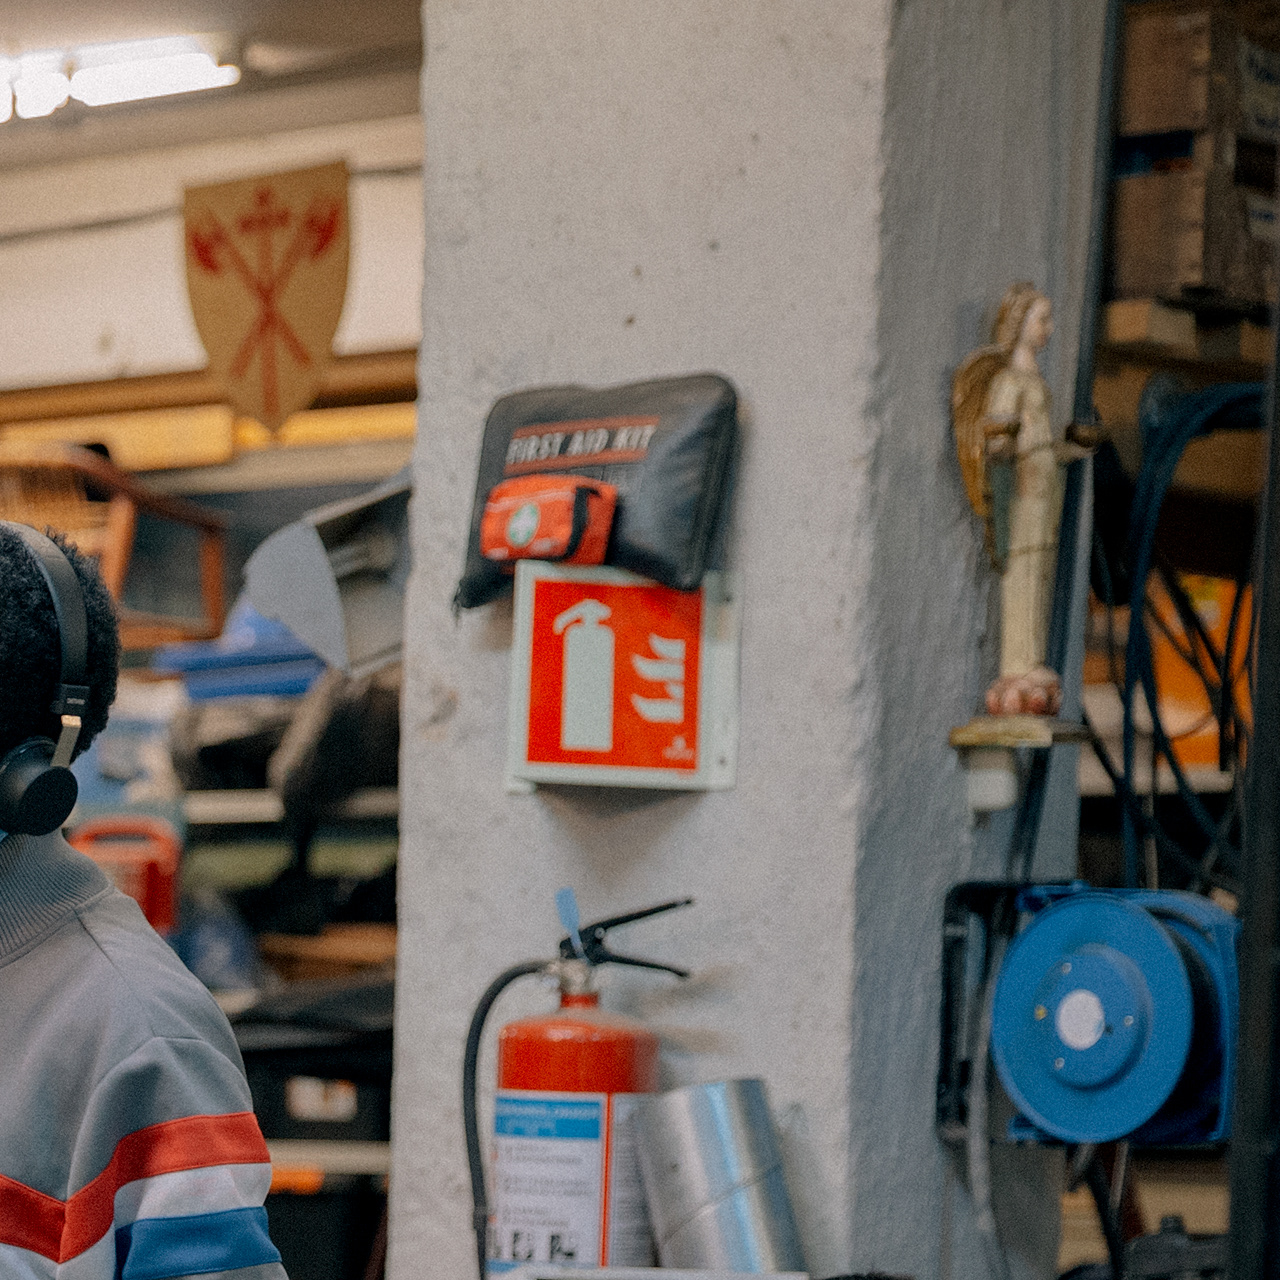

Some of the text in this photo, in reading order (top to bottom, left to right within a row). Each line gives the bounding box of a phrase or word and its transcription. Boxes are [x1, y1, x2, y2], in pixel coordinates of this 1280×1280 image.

[505, 424, 657, 465] FIRST AID KIT
